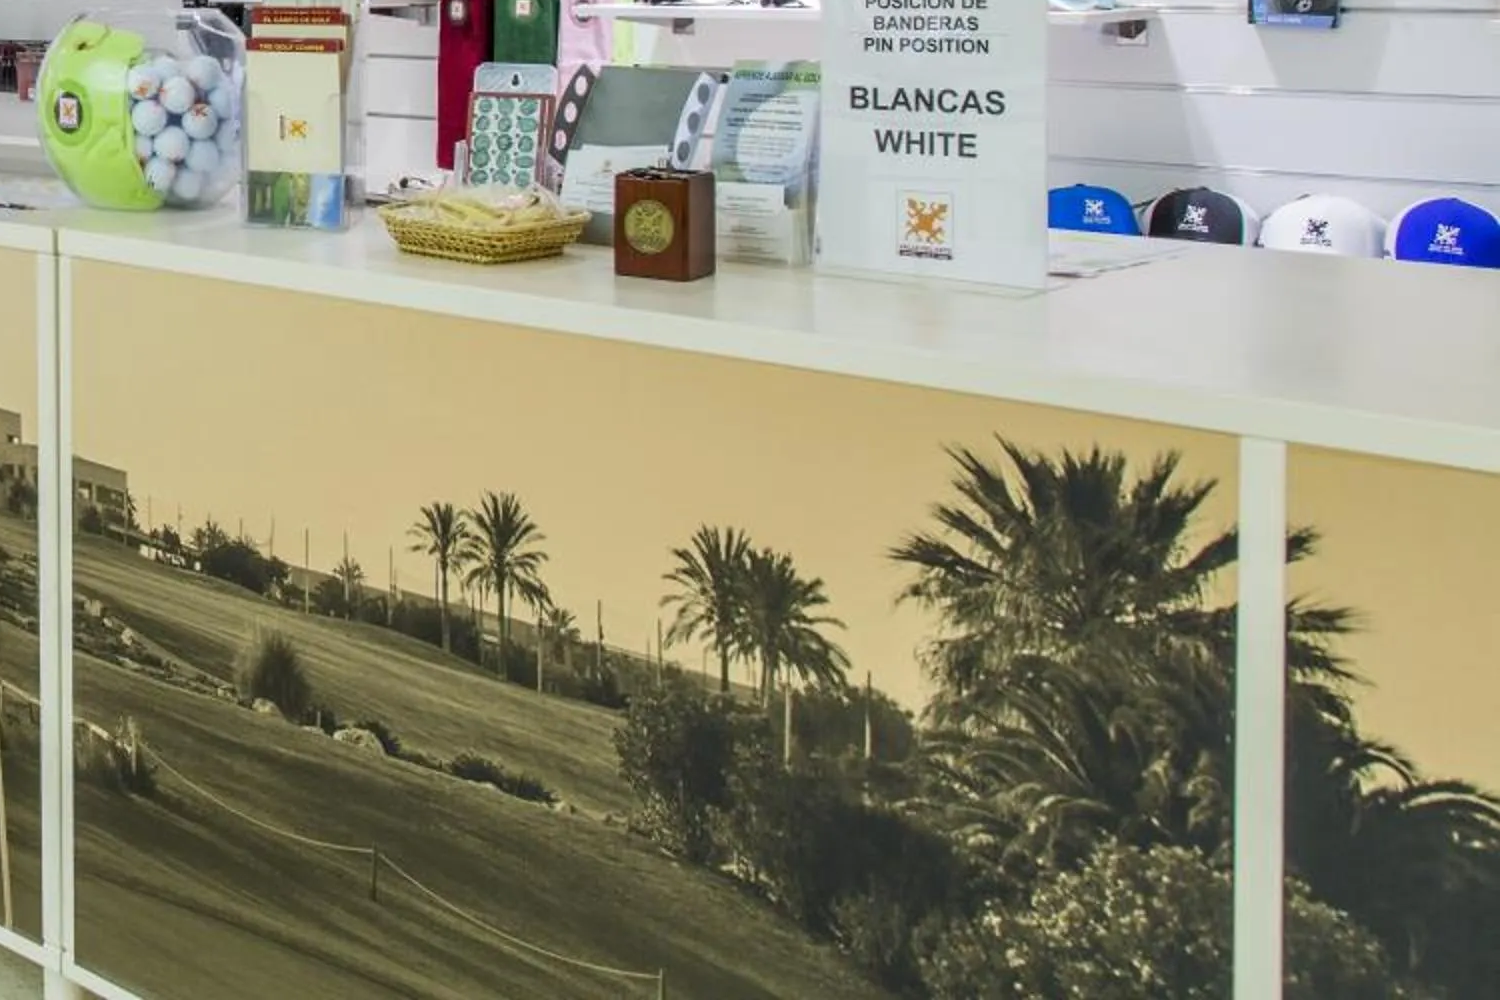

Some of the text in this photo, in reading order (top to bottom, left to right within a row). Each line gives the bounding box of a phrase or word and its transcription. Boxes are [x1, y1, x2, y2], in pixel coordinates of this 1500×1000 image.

[873, 16, 979, 31] BANDERAS
[863, 37, 990, 55] PIN POSITION
[850, 85, 1006, 116] BLANCAS
[874, 129, 978, 158] WHITE
